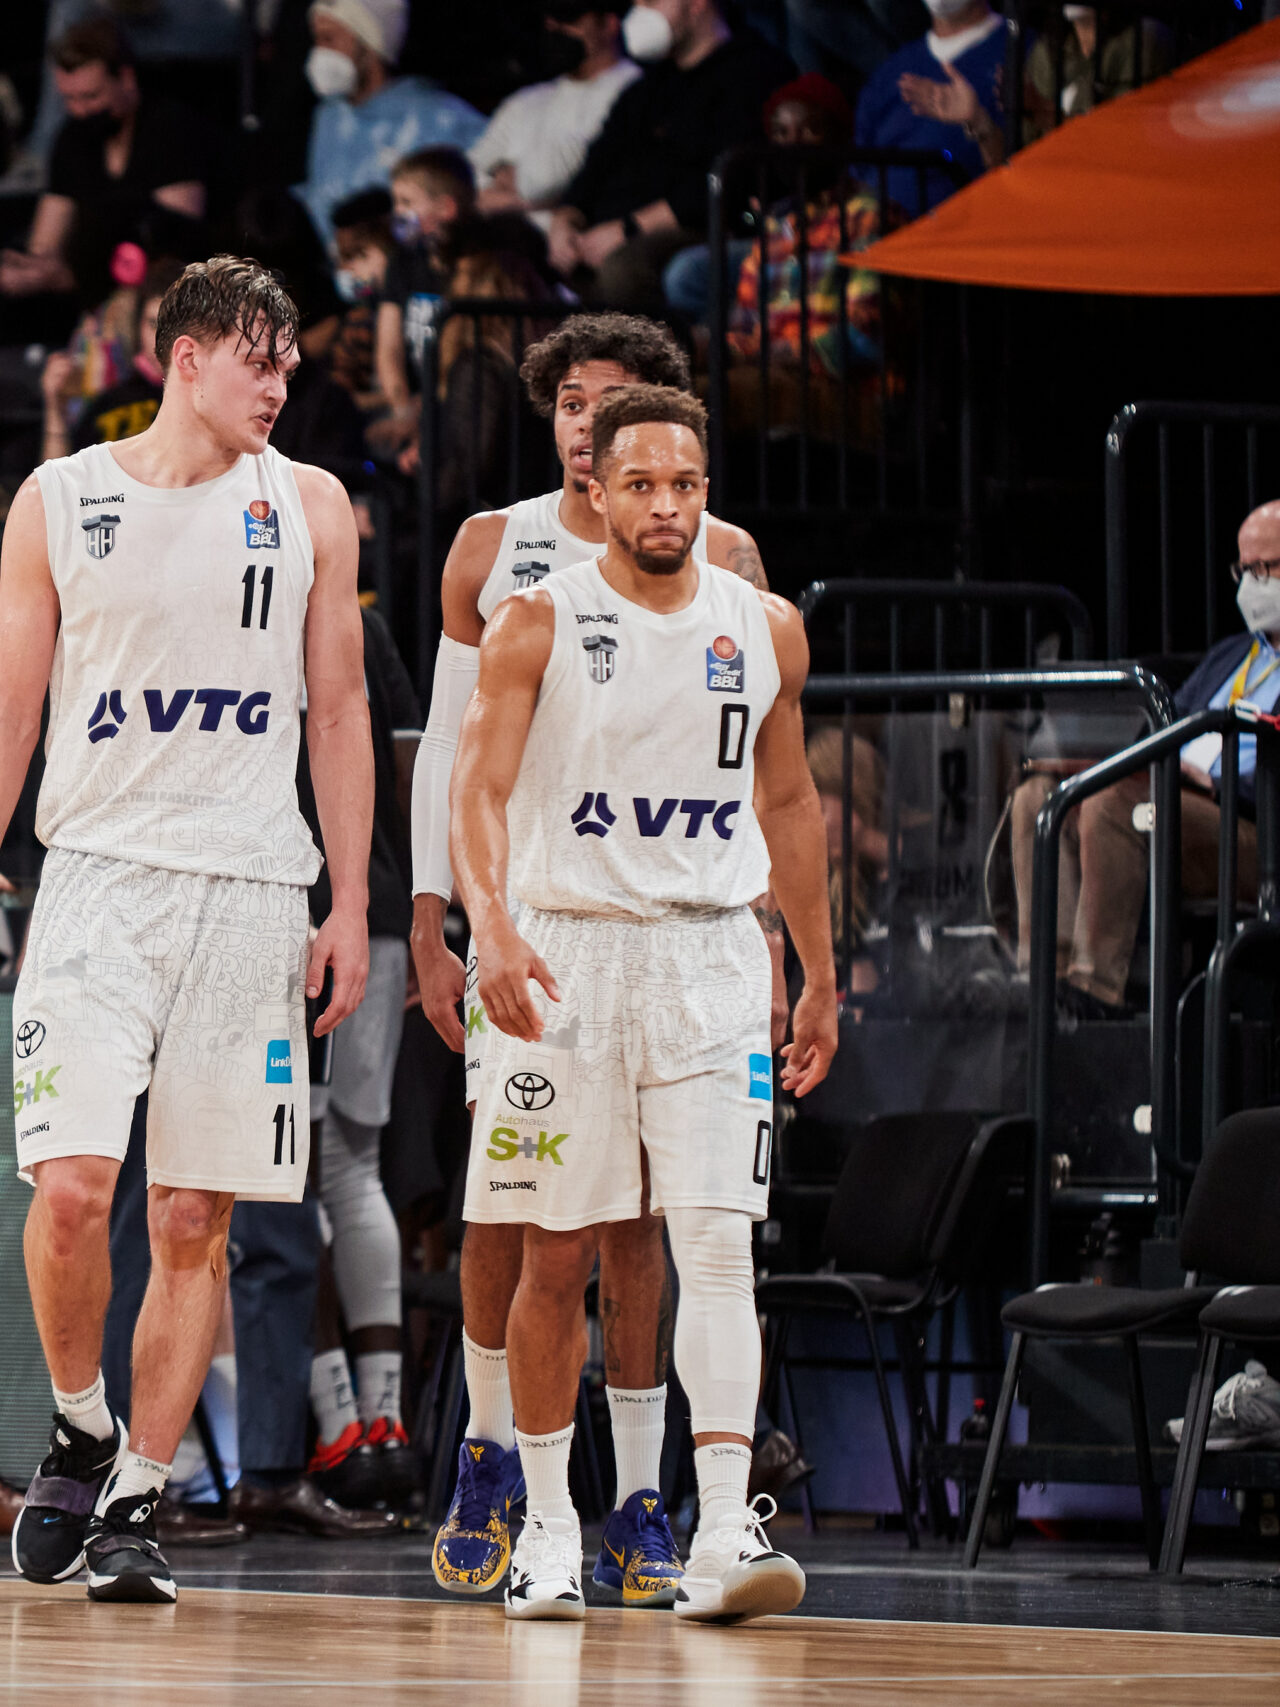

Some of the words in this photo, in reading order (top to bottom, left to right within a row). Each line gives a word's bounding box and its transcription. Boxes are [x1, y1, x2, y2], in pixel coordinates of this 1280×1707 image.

[80, 494, 125, 507] SPALDING
[514, 539, 556, 551] SPALDING
[241, 564, 274, 630] 11
[575, 613, 618, 625] SPALDING
[710, 674, 741, 689] BBL
[143, 688, 272, 735] VTG
[718, 703, 750, 769] 0
[495, 1113, 550, 1128] Autohaus
[272, 1103, 295, 1166] 11
[486, 1126, 570, 1166] S+K
[489, 1181, 537, 1192] SPALDING
